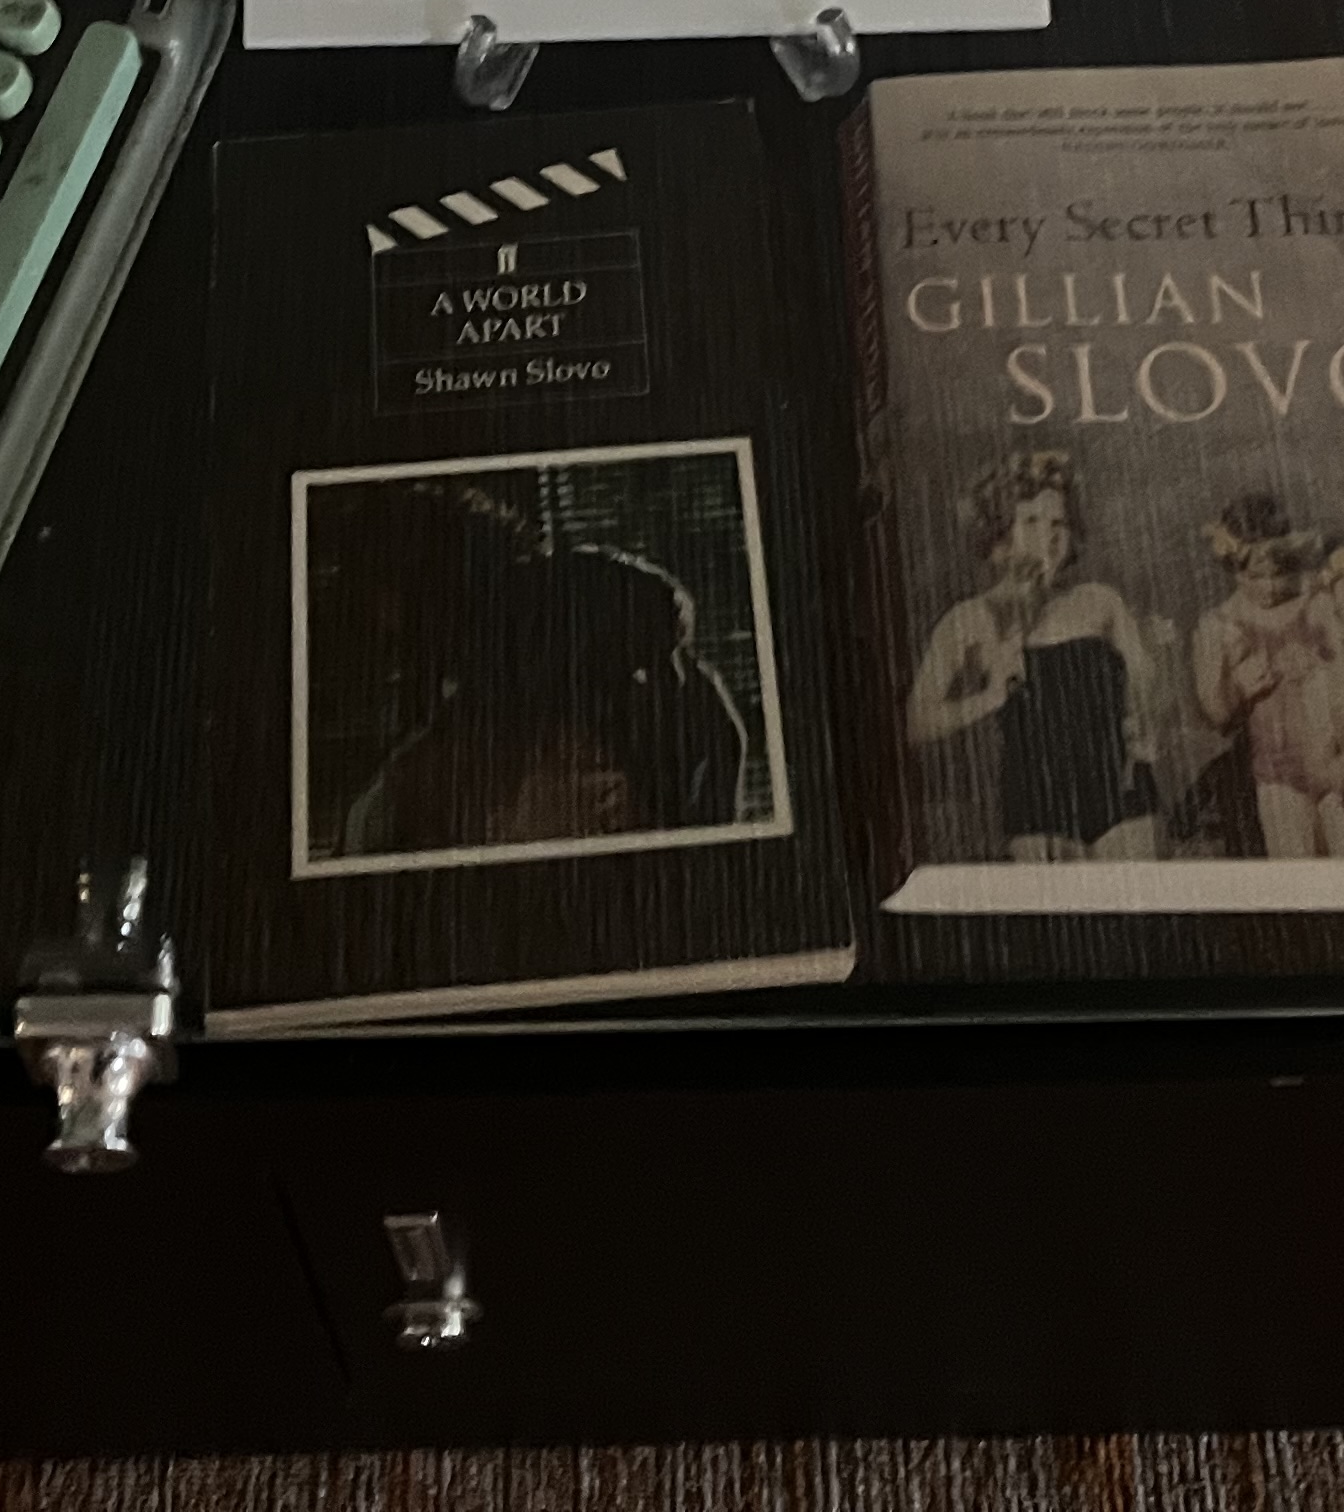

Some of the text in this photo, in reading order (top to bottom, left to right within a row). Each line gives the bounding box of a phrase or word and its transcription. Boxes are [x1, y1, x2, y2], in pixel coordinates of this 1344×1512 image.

[901, 206, 1047, 258] Every
[1065, 197, 1218, 243] Secret
[431, 280, 588, 316] A WORLD
[906, 270, 1266, 333] GILLIAN
[457, 312, 564, 344] APART
[415, 357, 610, 395] Shawn Slovo
